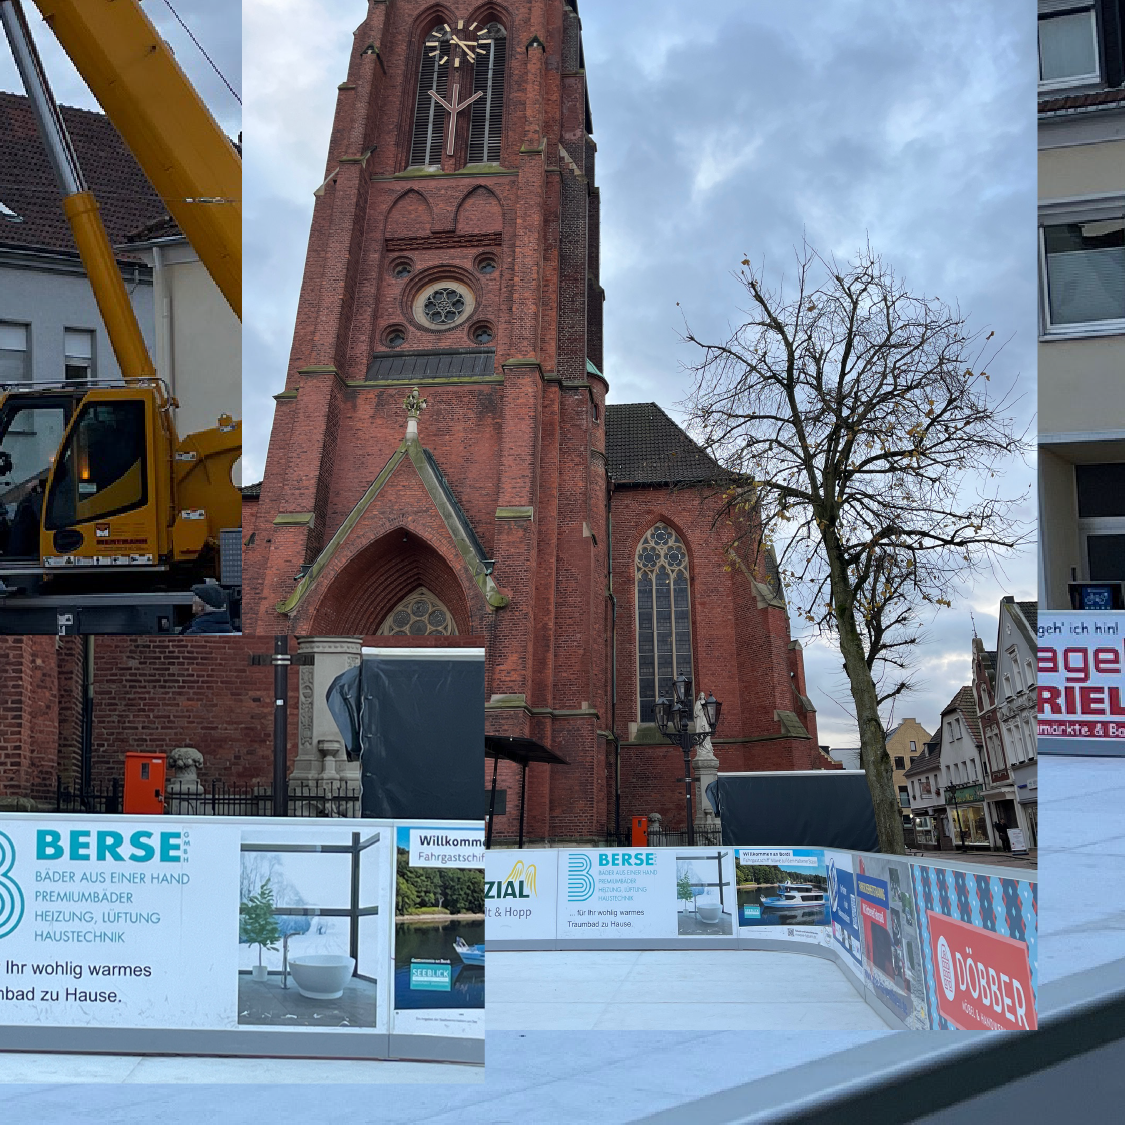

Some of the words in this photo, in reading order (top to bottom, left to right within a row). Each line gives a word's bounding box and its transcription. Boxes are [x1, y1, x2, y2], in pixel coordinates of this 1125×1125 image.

[1070, 622, 1089, 635] ich
[1095, 622, 1119, 635] hin!
[1037, 638, 1125, 683] age
[36, 829, 182, 863] BERSE
[598, 852, 654, 866] BERSE
[35, 867, 76, 883] BÄDER
[80, 871, 106, 884] AUS
[111, 871, 146, 884] EINER
[151, 872, 191, 885] HAND
[35, 888, 133, 904] PREMIUMBÄDER
[35, 911, 98, 925] HEIZUNG,
[102, 908, 161, 924] LÜFTUNG
[494, 907, 502, 917] &
[505, 907, 532, 919] Hopp
[597, 909, 618, 918] wohlig
[34, 930, 125, 943] HAUSTECHNIK
[6, 960, 27, 975] Ihr
[31, 961, 83, 979] wohlig
[88, 964, 152, 977] warmes
[412, 968, 449, 977] SEEBLICK
[40, 990, 59, 1001] zu
[65, 988, 122, 1002] Hause.
[955, 946, 1030, 1030] DÖBBER
